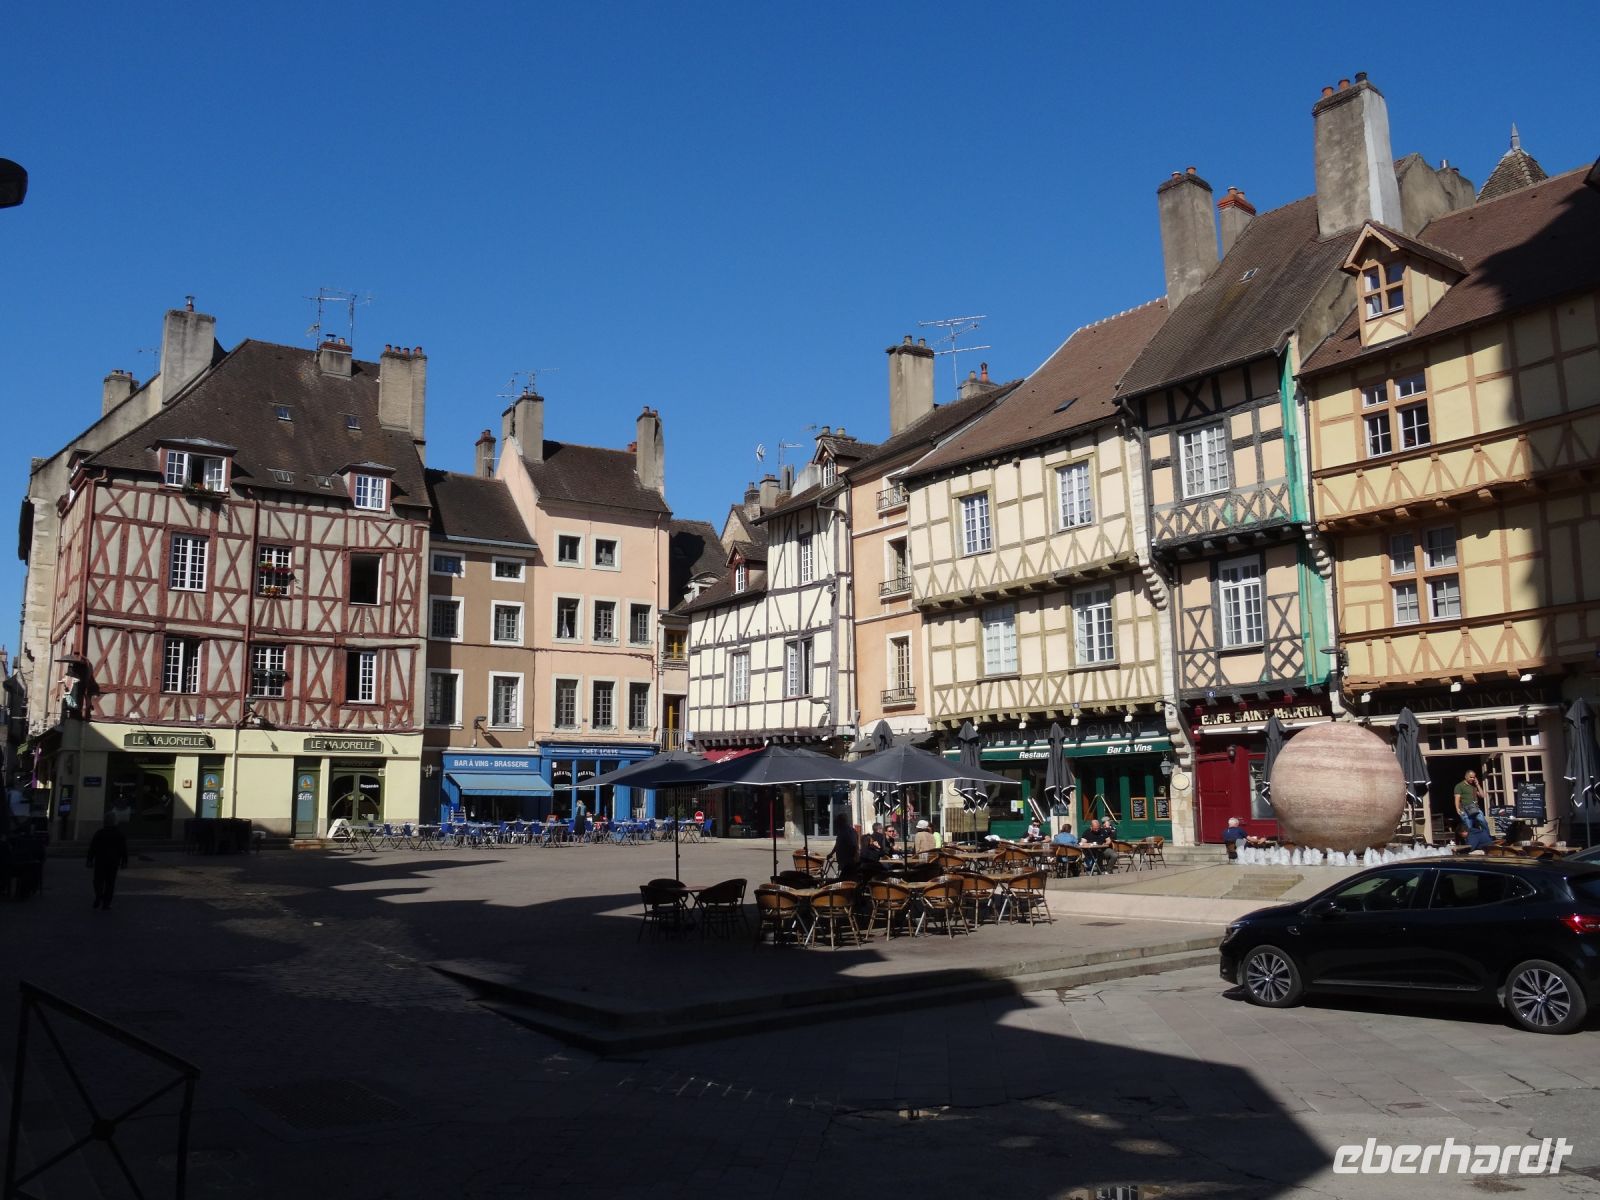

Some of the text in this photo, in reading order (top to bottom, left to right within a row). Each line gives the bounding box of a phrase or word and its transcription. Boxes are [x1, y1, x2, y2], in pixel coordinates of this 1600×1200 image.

[1235, 709, 1269, 723] SAINT
[1273, 704, 1323, 719] MARTIN
[132, 735, 144, 745] LE
[310, 740, 375, 750] LE MAJORELLE
[1107, 743, 1152, 754] Bar à Vins
[1019, 751, 1050, 759] Restaur
[454, 759, 467, 767] BAR
